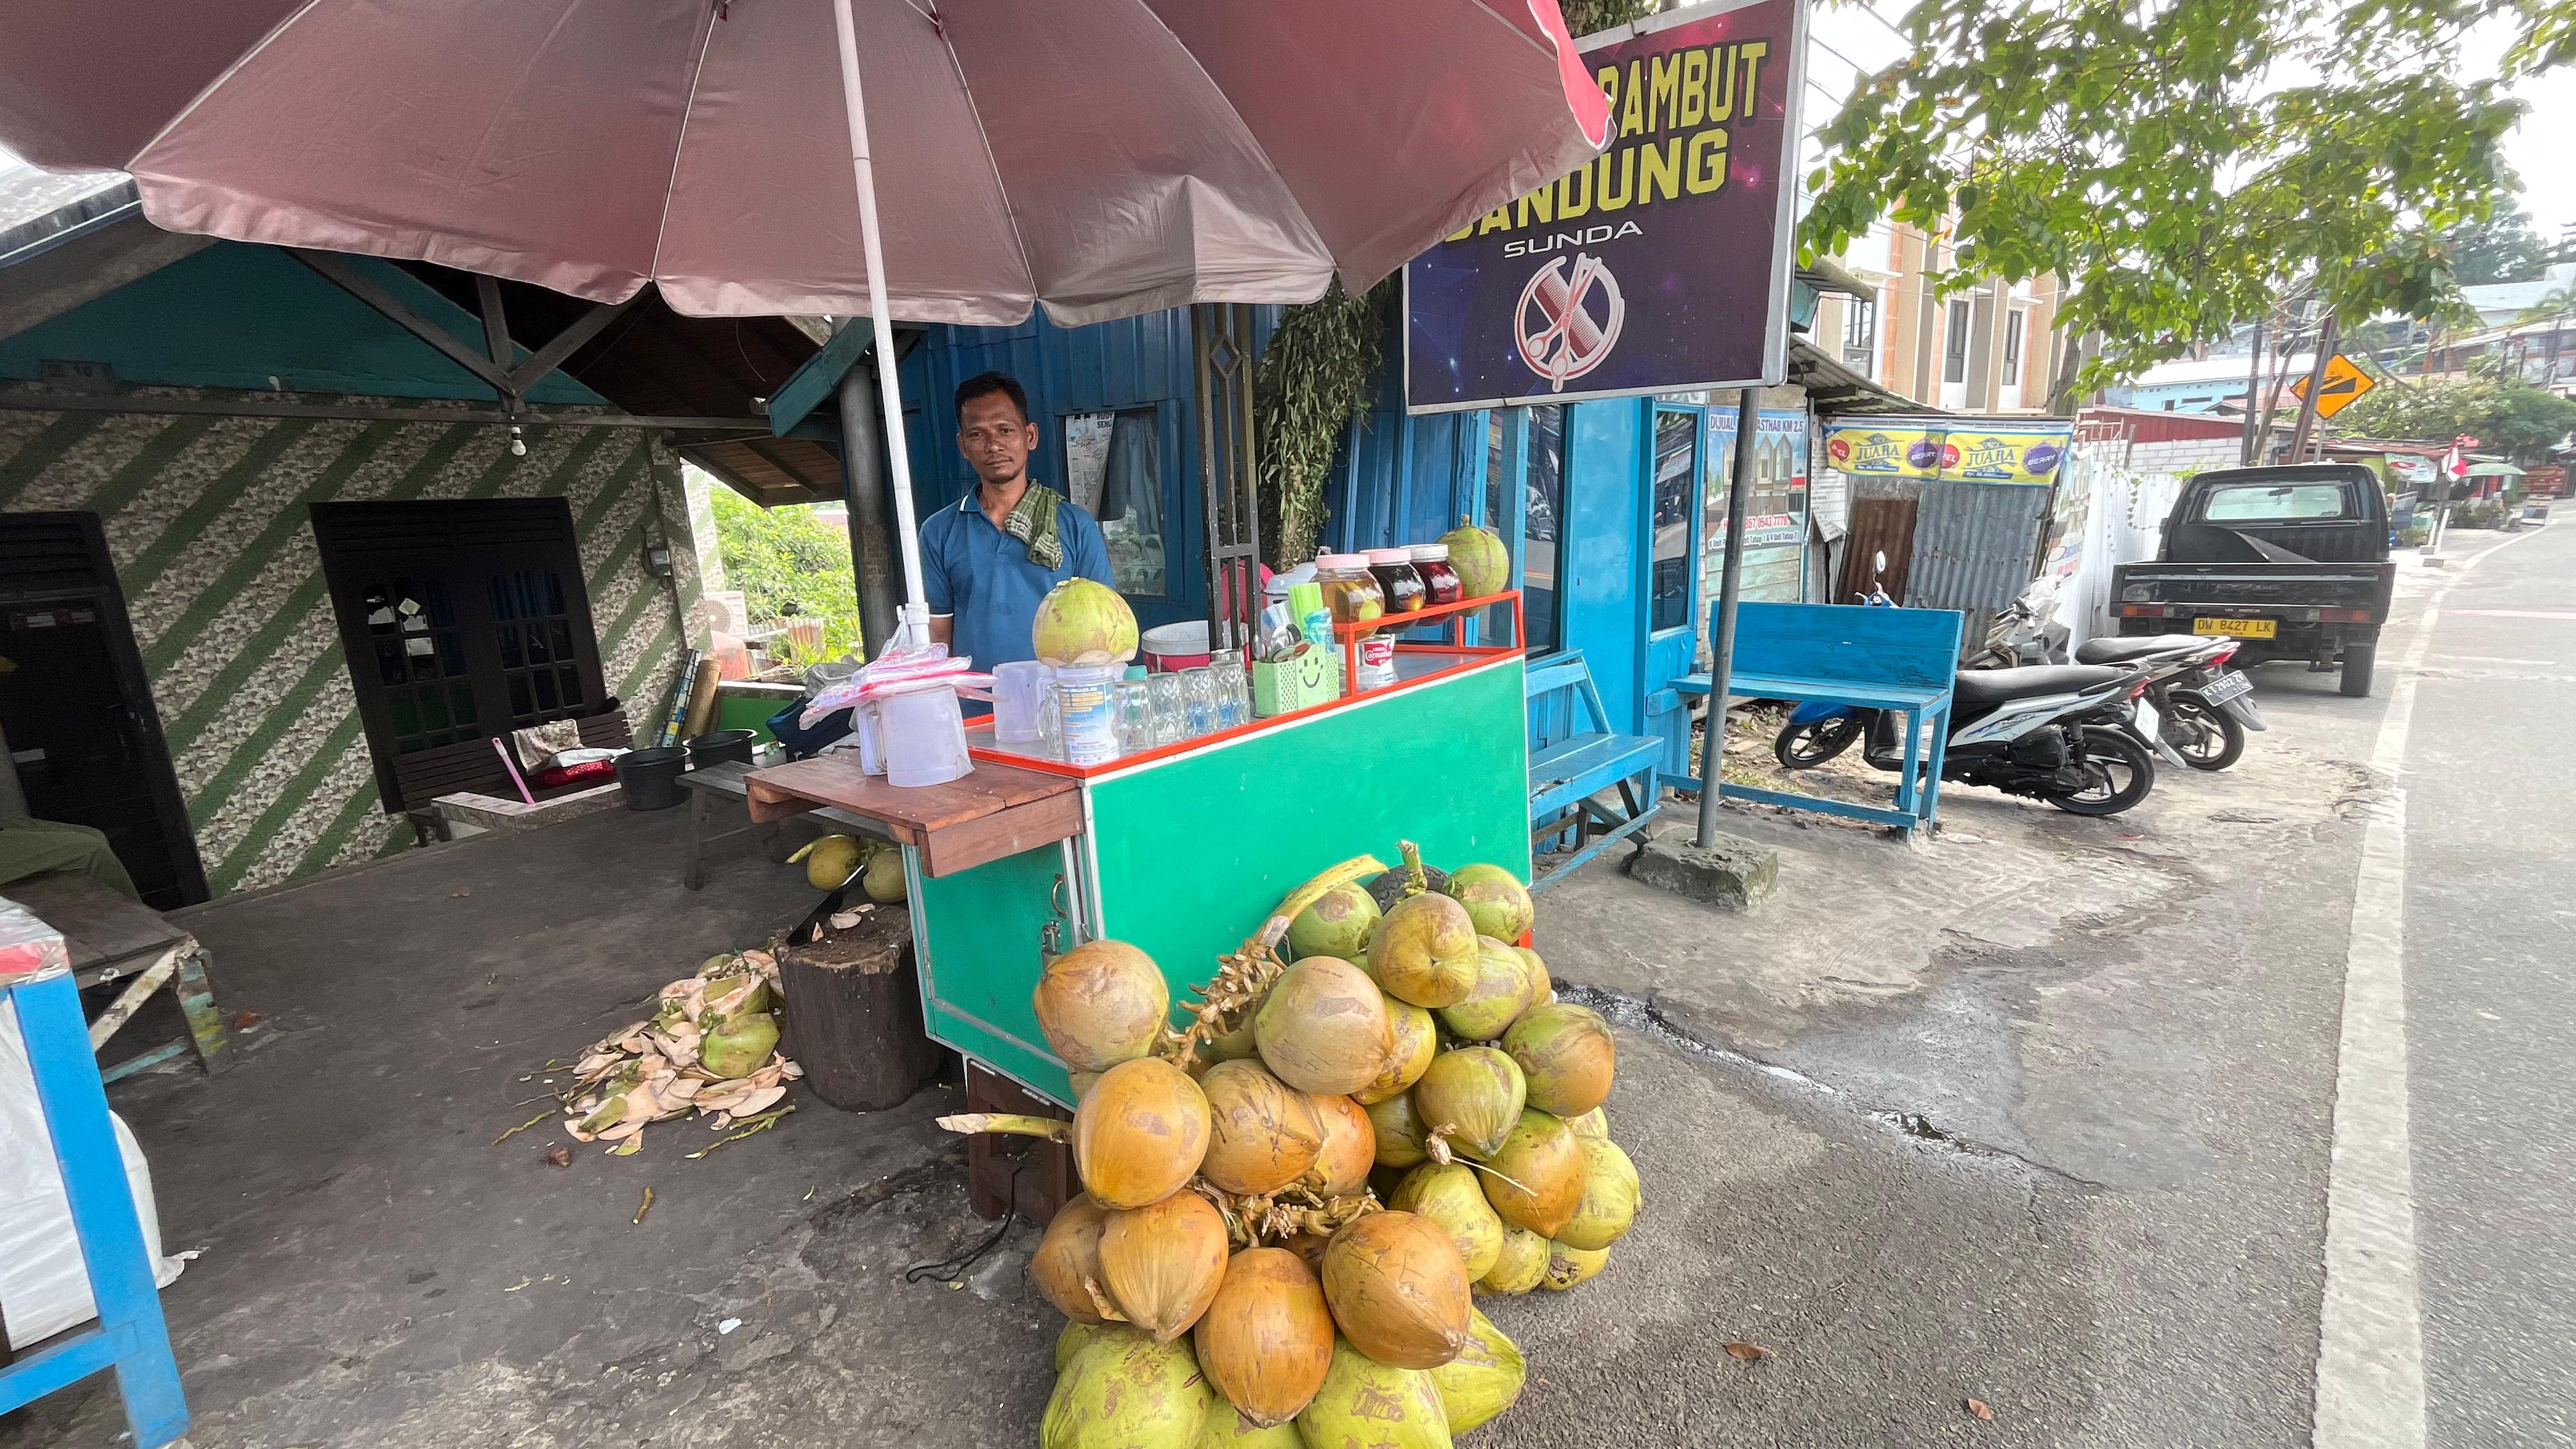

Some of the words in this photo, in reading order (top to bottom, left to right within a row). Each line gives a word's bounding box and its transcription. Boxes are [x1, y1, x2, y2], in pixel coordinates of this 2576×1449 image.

[1445, 129, 1728, 242] ANDUNG
[1504, 220, 1643, 258] SUNDA
[1710, 416, 1735, 429] DIJUAL
[1782, 420, 1792, 432] KM
[1793, 420, 1804, 432] 2.5
[1857, 443, 1901, 461] JUARA
[1911, 451, 1936, 461] BERRY
[1966, 448, 2015, 466] JUARA
[2027, 454, 2057, 466] BERRY
[2220, 620, 2249, 631] 8427
[2256, 621, 2271, 632] LK
[2202, 686, 2216, 697] KT
